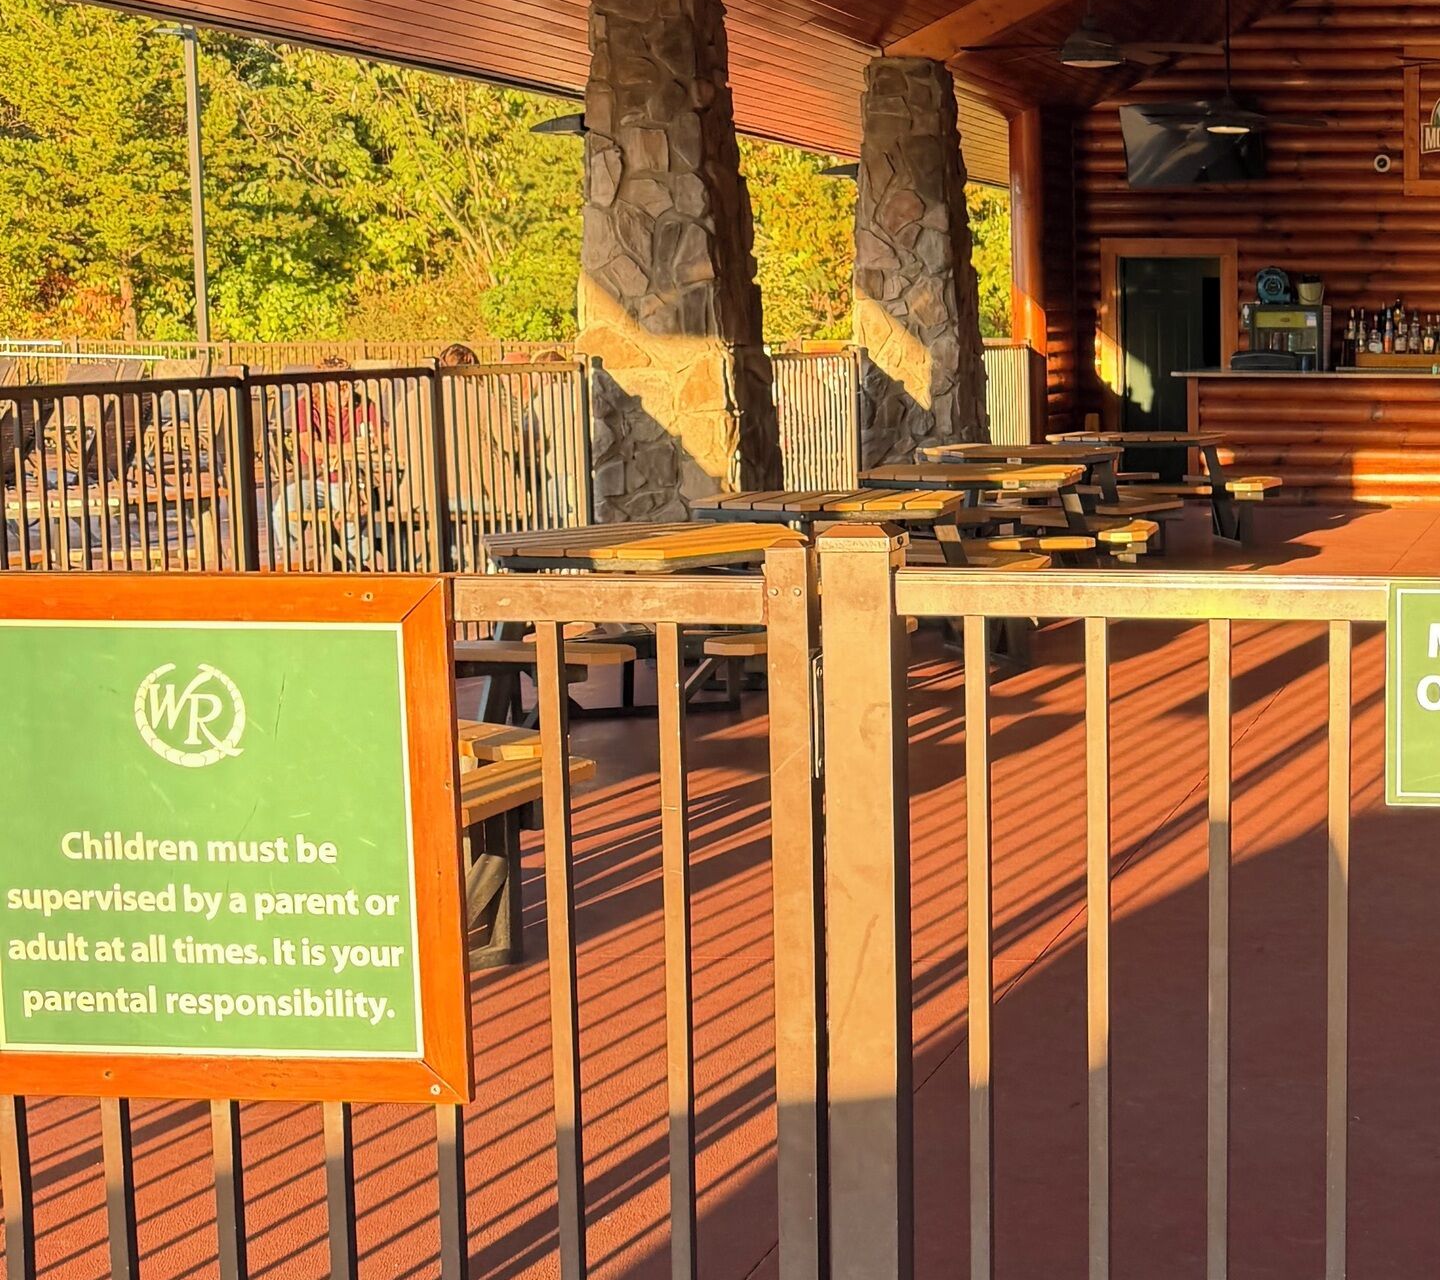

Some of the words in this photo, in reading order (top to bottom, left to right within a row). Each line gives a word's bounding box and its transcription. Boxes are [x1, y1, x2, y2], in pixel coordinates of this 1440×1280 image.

[61, 831, 199, 862] Children
[206, 837, 290, 864] must
[295, 833, 338, 864] be
[7, 882, 177, 917] supervised
[182, 883, 223, 921] by
[228, 892, 248, 914] a
[254, 889, 360, 921] parent
[364, 893, 400, 917] or
[8, 932, 90, 962] adult
[94, 937, 126, 963] at
[130, 934, 167, 964] all
[172, 935, 268, 966] times.
[272, 937, 297, 966] It
[301, 937, 327, 967] is
[330, 945, 405, 975] your
[23, 985, 158, 1022] parental
[165, 988, 396, 1026] responsibility.
